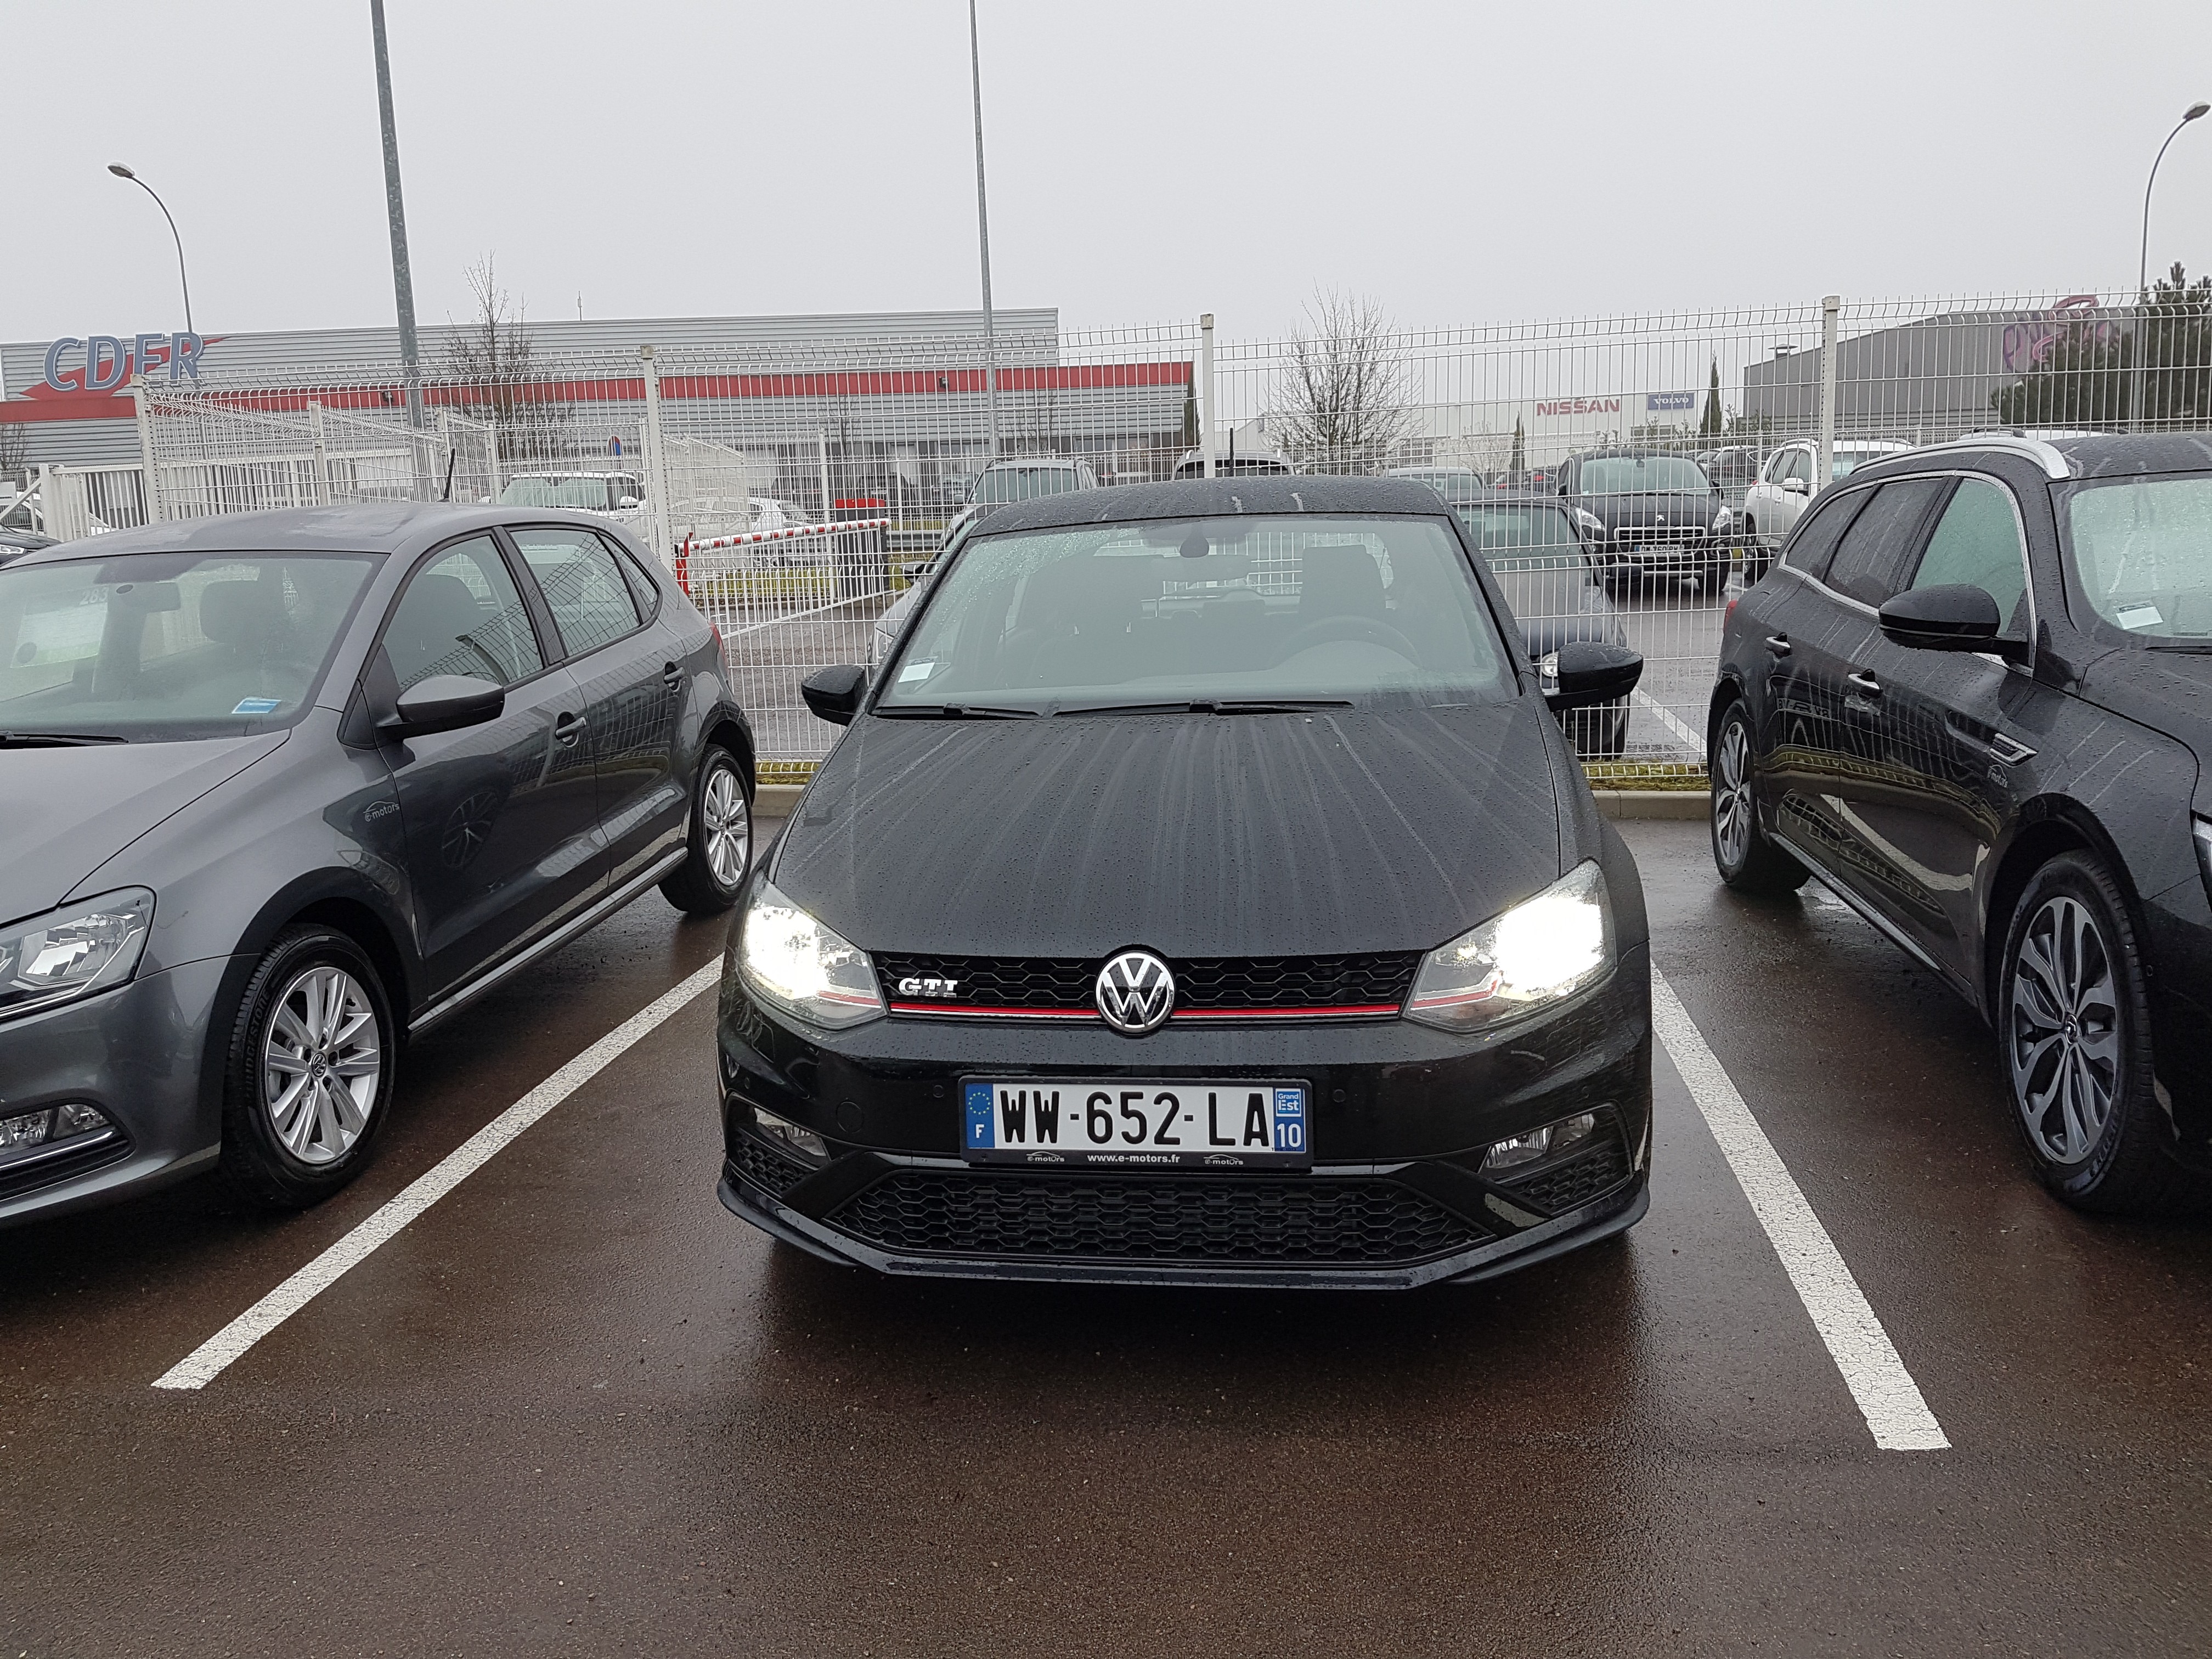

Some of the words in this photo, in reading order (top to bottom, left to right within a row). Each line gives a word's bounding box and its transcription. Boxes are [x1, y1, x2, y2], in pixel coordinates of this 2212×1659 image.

[43, 332, 204, 391] CDER
[1537, 399, 1620, 416] NISSAN
[899, 978, 958, 998] GTI
[1278, 1099, 1299, 1111] Est
[1000, 1090, 1269, 1147] WW-652-LA
[975, 1124, 985, 1138] F
[1277, 1123, 1301, 1147] 10
[1087, 1154, 1180, 1163] www.e-motors.fr
